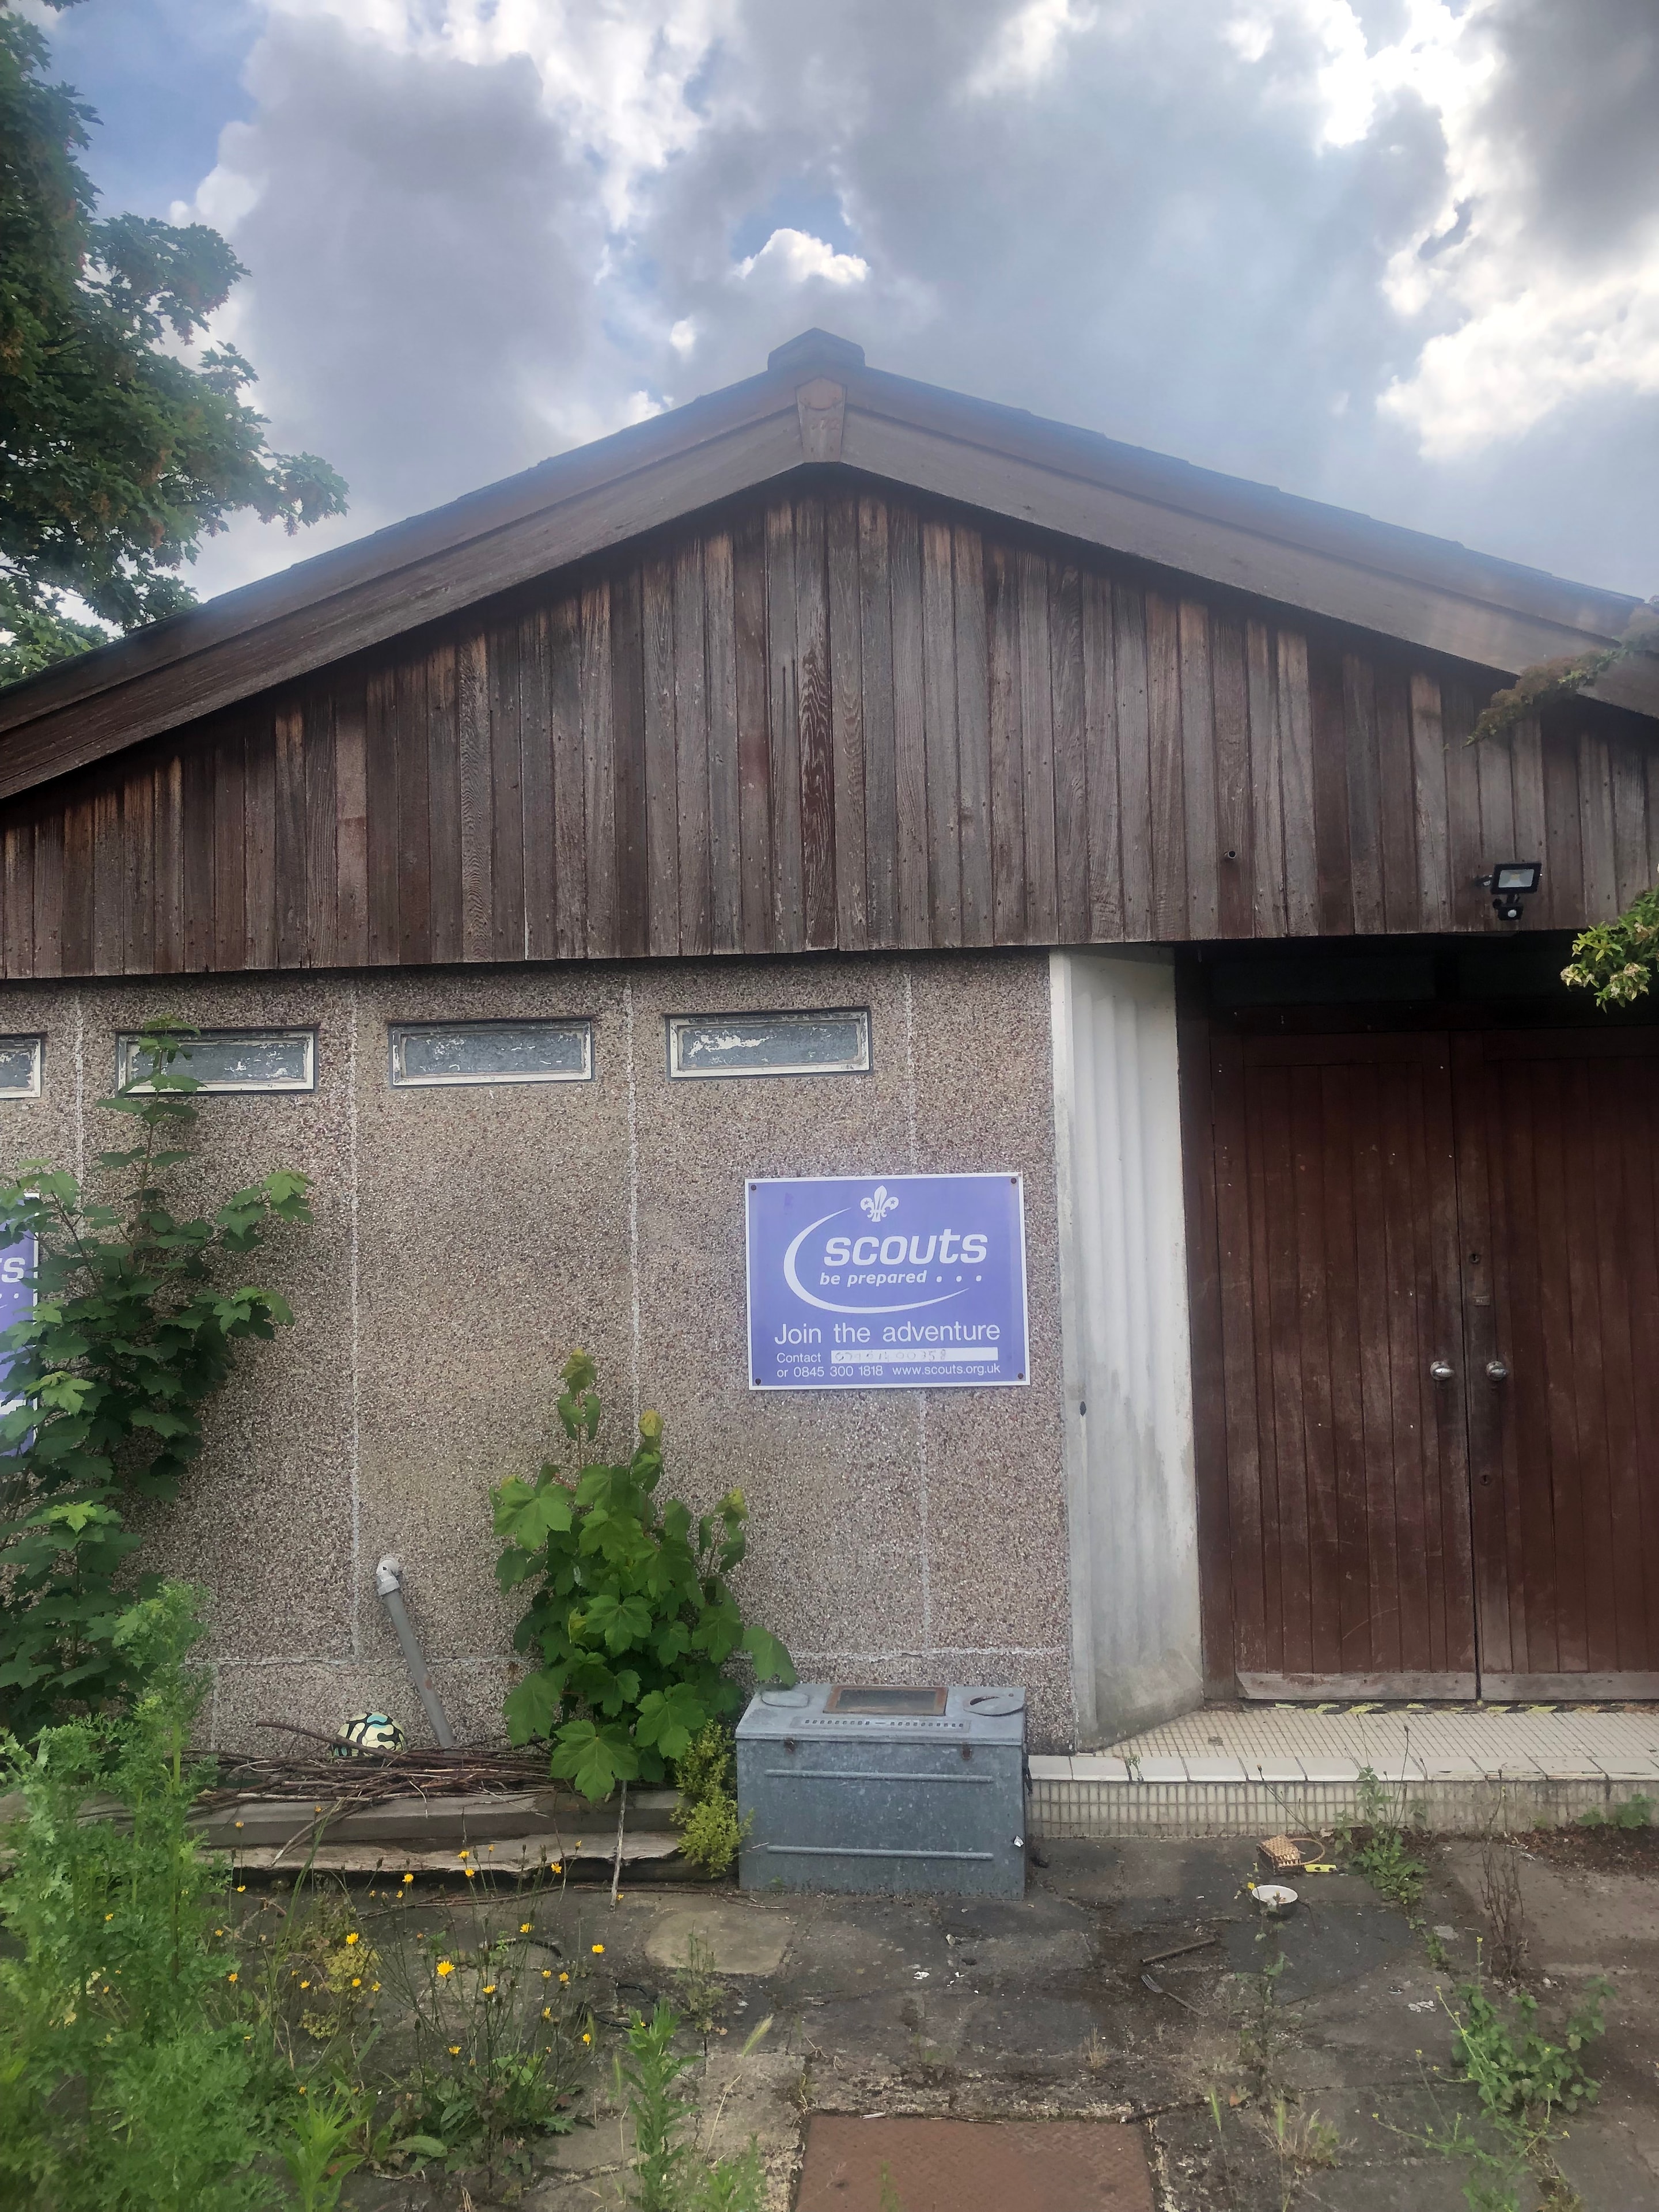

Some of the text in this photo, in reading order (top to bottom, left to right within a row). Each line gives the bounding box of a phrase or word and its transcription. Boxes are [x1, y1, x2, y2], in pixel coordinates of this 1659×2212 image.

[824, 1229, 988, 1266] scouts
[820, 1272, 840, 1285] be
[847, 1270, 927, 1287] prepared
[774, 1321, 1000, 1344] Join the adventure
[777, 1353, 821, 1363] Contact
[777, 1363, 1001, 1378] or 0845 300 1818 www.scouts.org.uk
